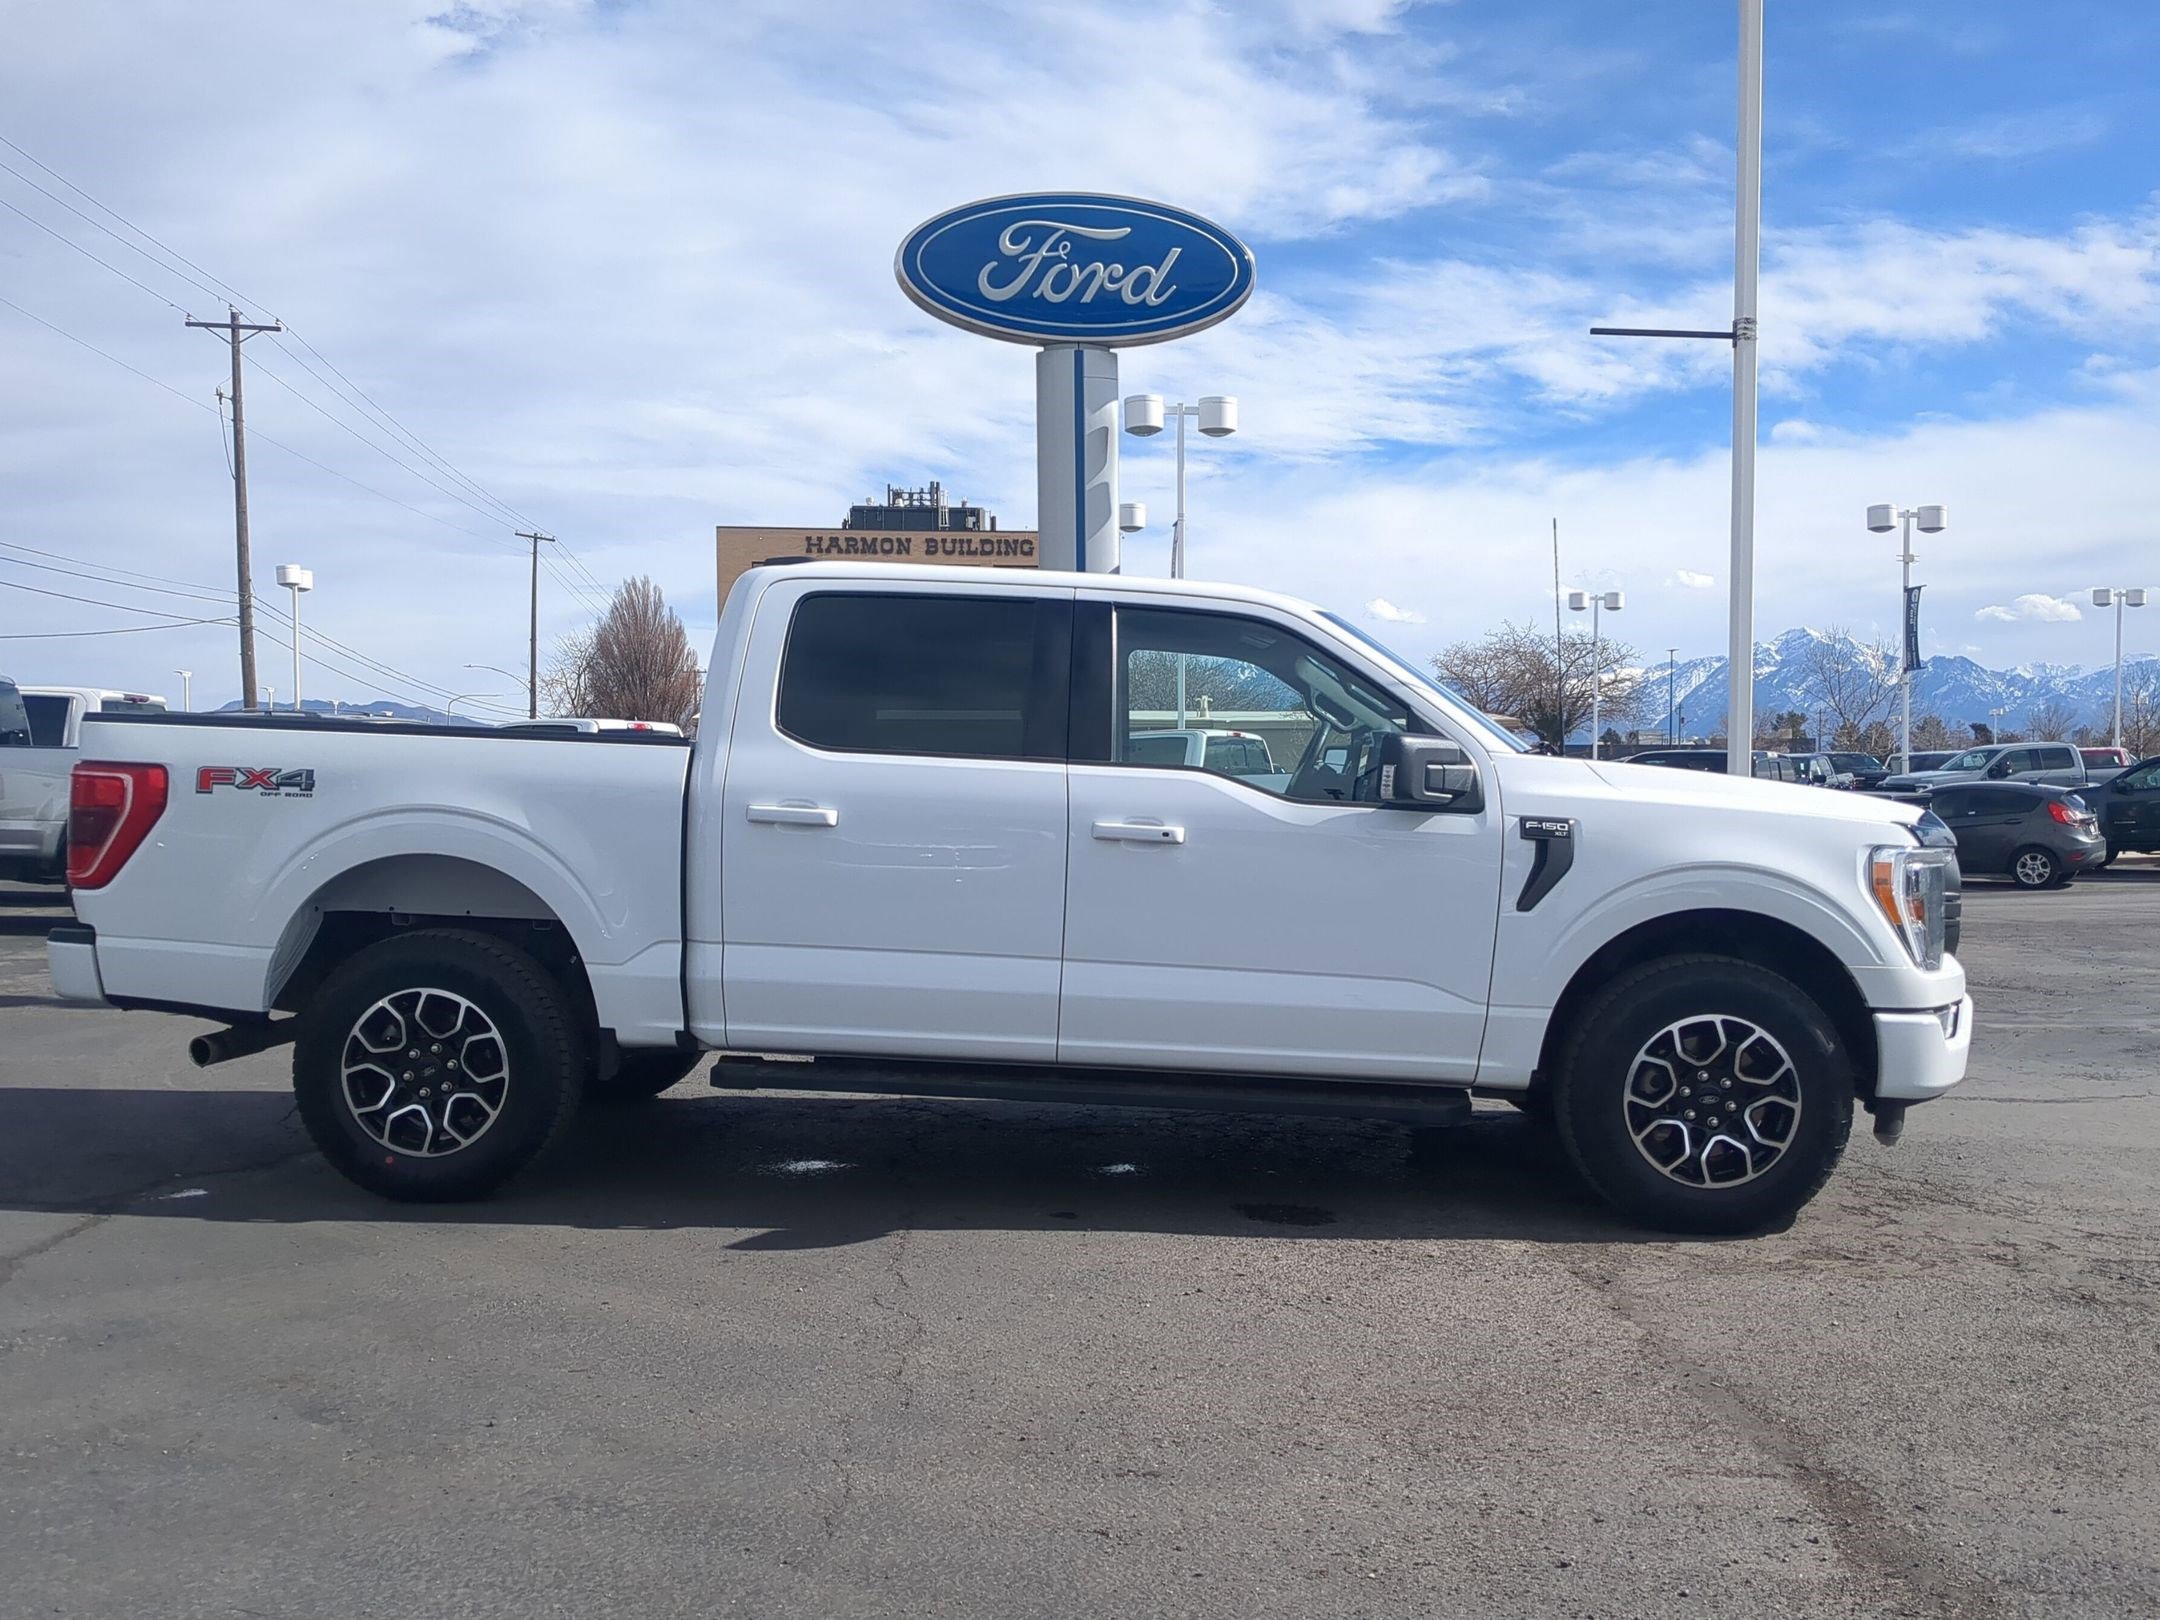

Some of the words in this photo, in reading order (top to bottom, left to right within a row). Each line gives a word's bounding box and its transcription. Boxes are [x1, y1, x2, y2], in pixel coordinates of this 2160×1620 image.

[978, 220, 1183, 306] Ford
[804, 535, 912, 555] HARMON
[924, 537, 1035, 557] BUILDING
[195, 766, 316, 794] FX4
[1525, 821, 1569, 831] F-150
